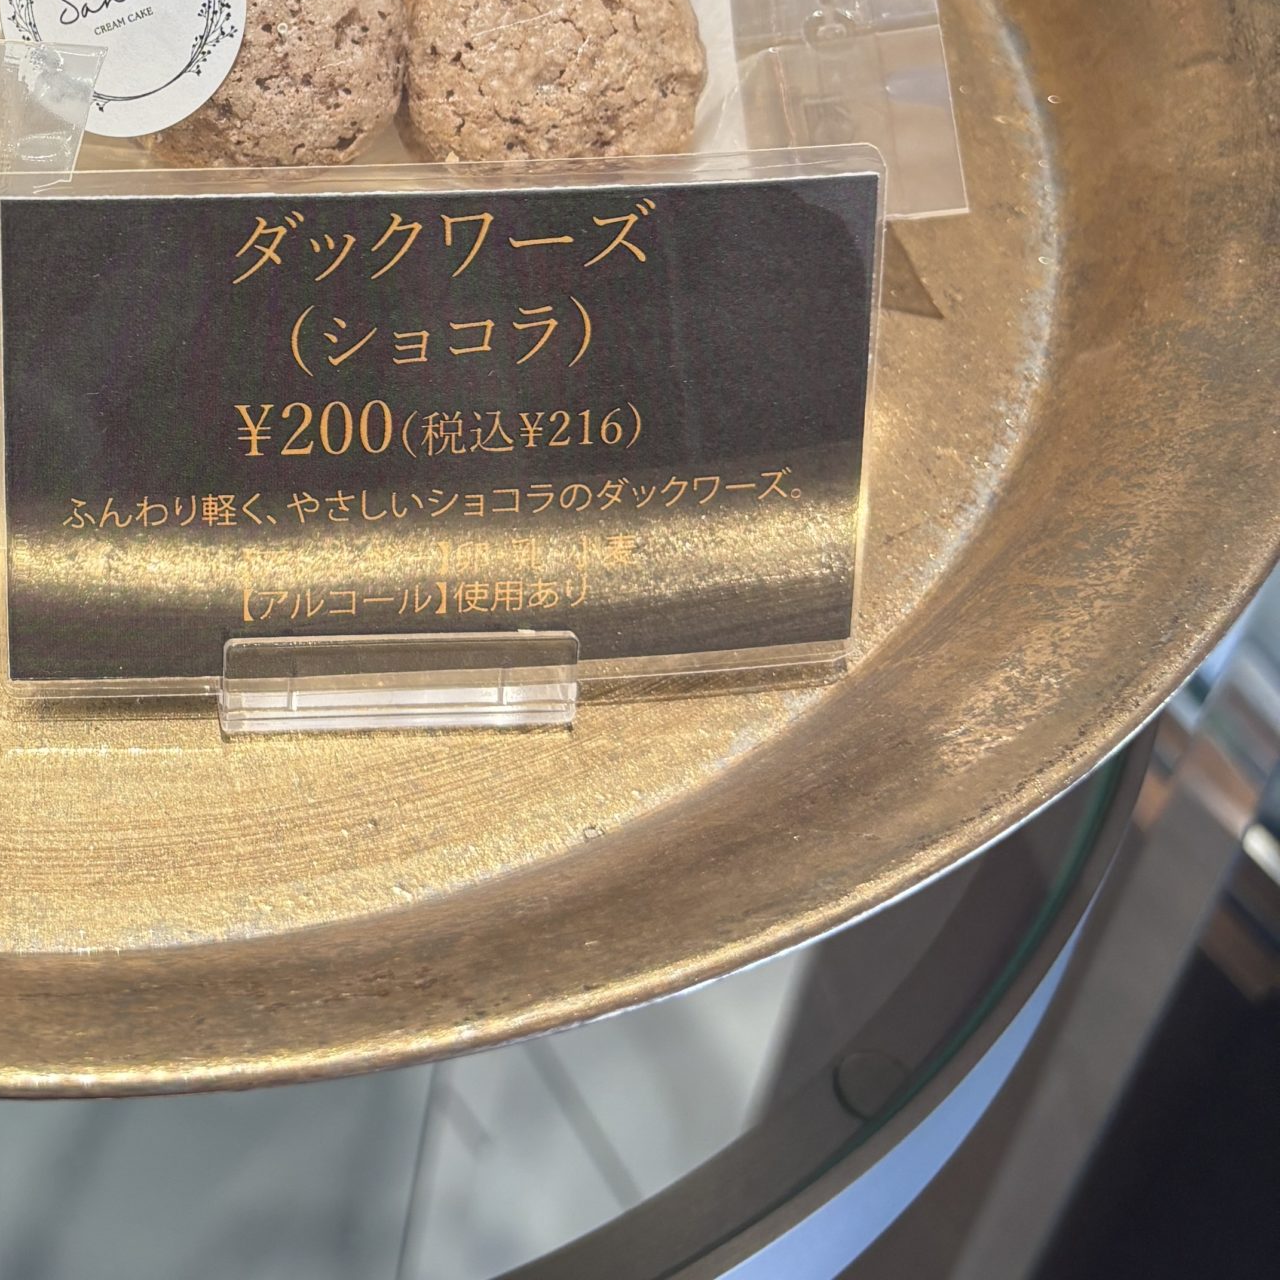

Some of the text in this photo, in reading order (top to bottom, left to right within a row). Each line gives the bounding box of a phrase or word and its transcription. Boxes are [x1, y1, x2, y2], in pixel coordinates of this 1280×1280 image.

[93, 6, 154, 36] CREAM CAKE
[232, 197, 657, 285] ダックワーズ
[291, 295, 592, 377] (ショコラ)
[63, 467, 802, 529] ふんわり軽く、やさしいショコラのダックワーズ。
[241, 578, 590, 622] 【アルコール】使用あり
